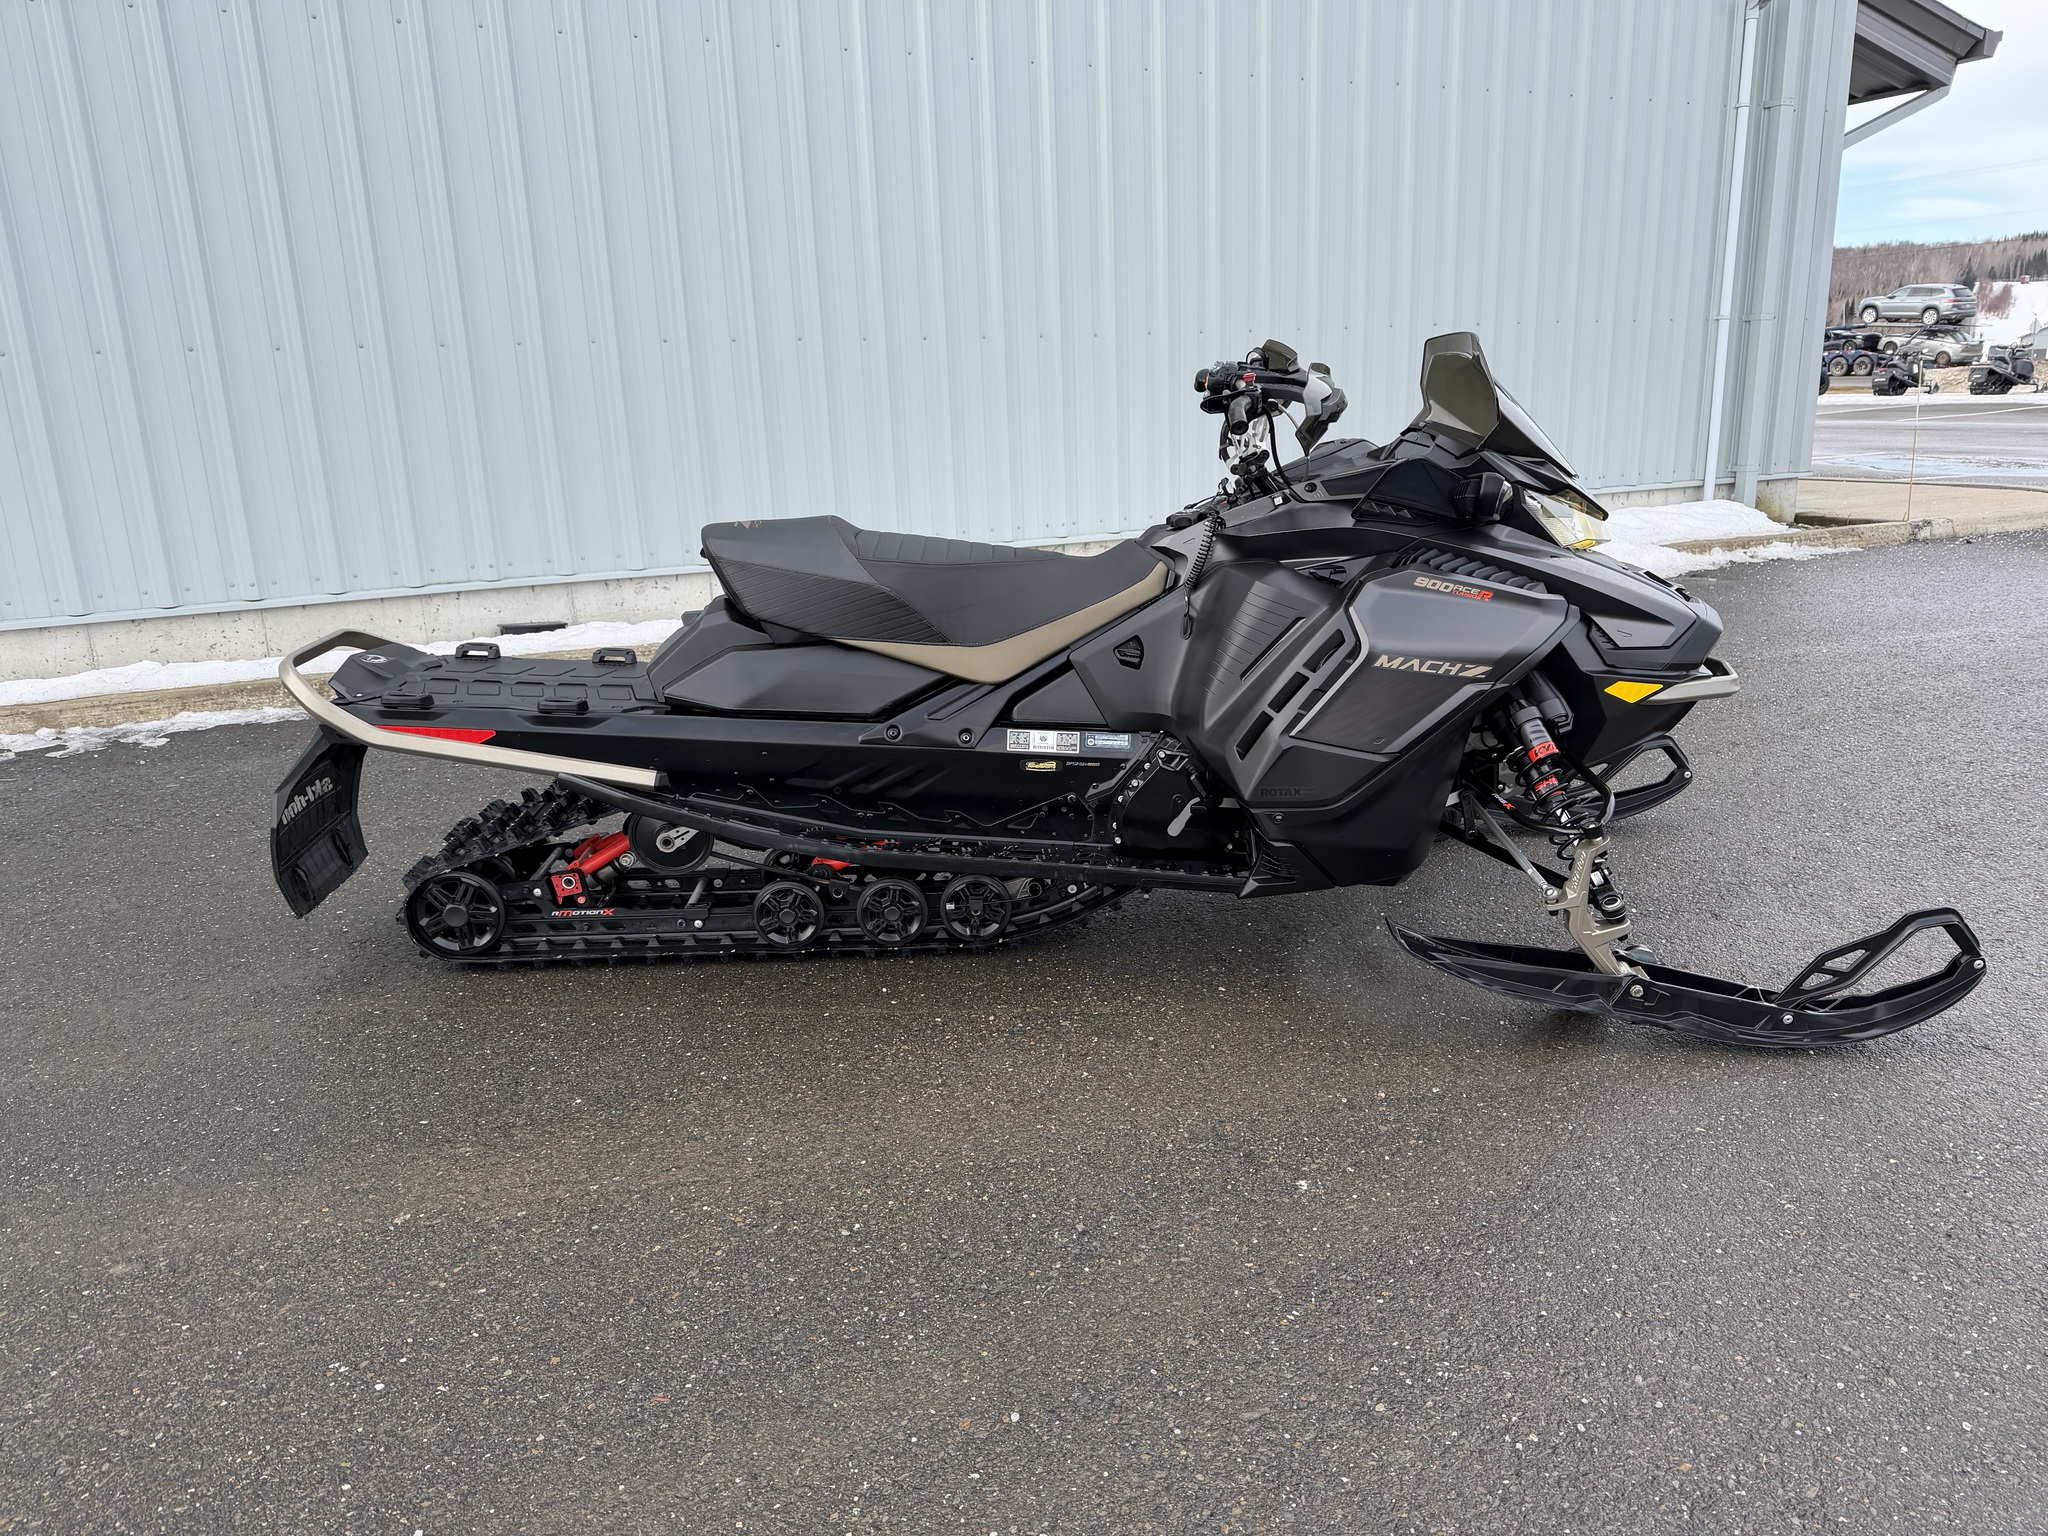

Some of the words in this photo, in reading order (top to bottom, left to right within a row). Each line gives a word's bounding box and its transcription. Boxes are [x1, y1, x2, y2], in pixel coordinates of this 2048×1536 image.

[1413, 576, 1455, 593] 900
[1453, 584, 1480, 595] ACE
[1477, 590, 1493, 601] R
[1373, 654, 1462, 676] MACH
[1457, 664, 1493, 678] Z
[1260, 787, 1302, 797] ROTAX
